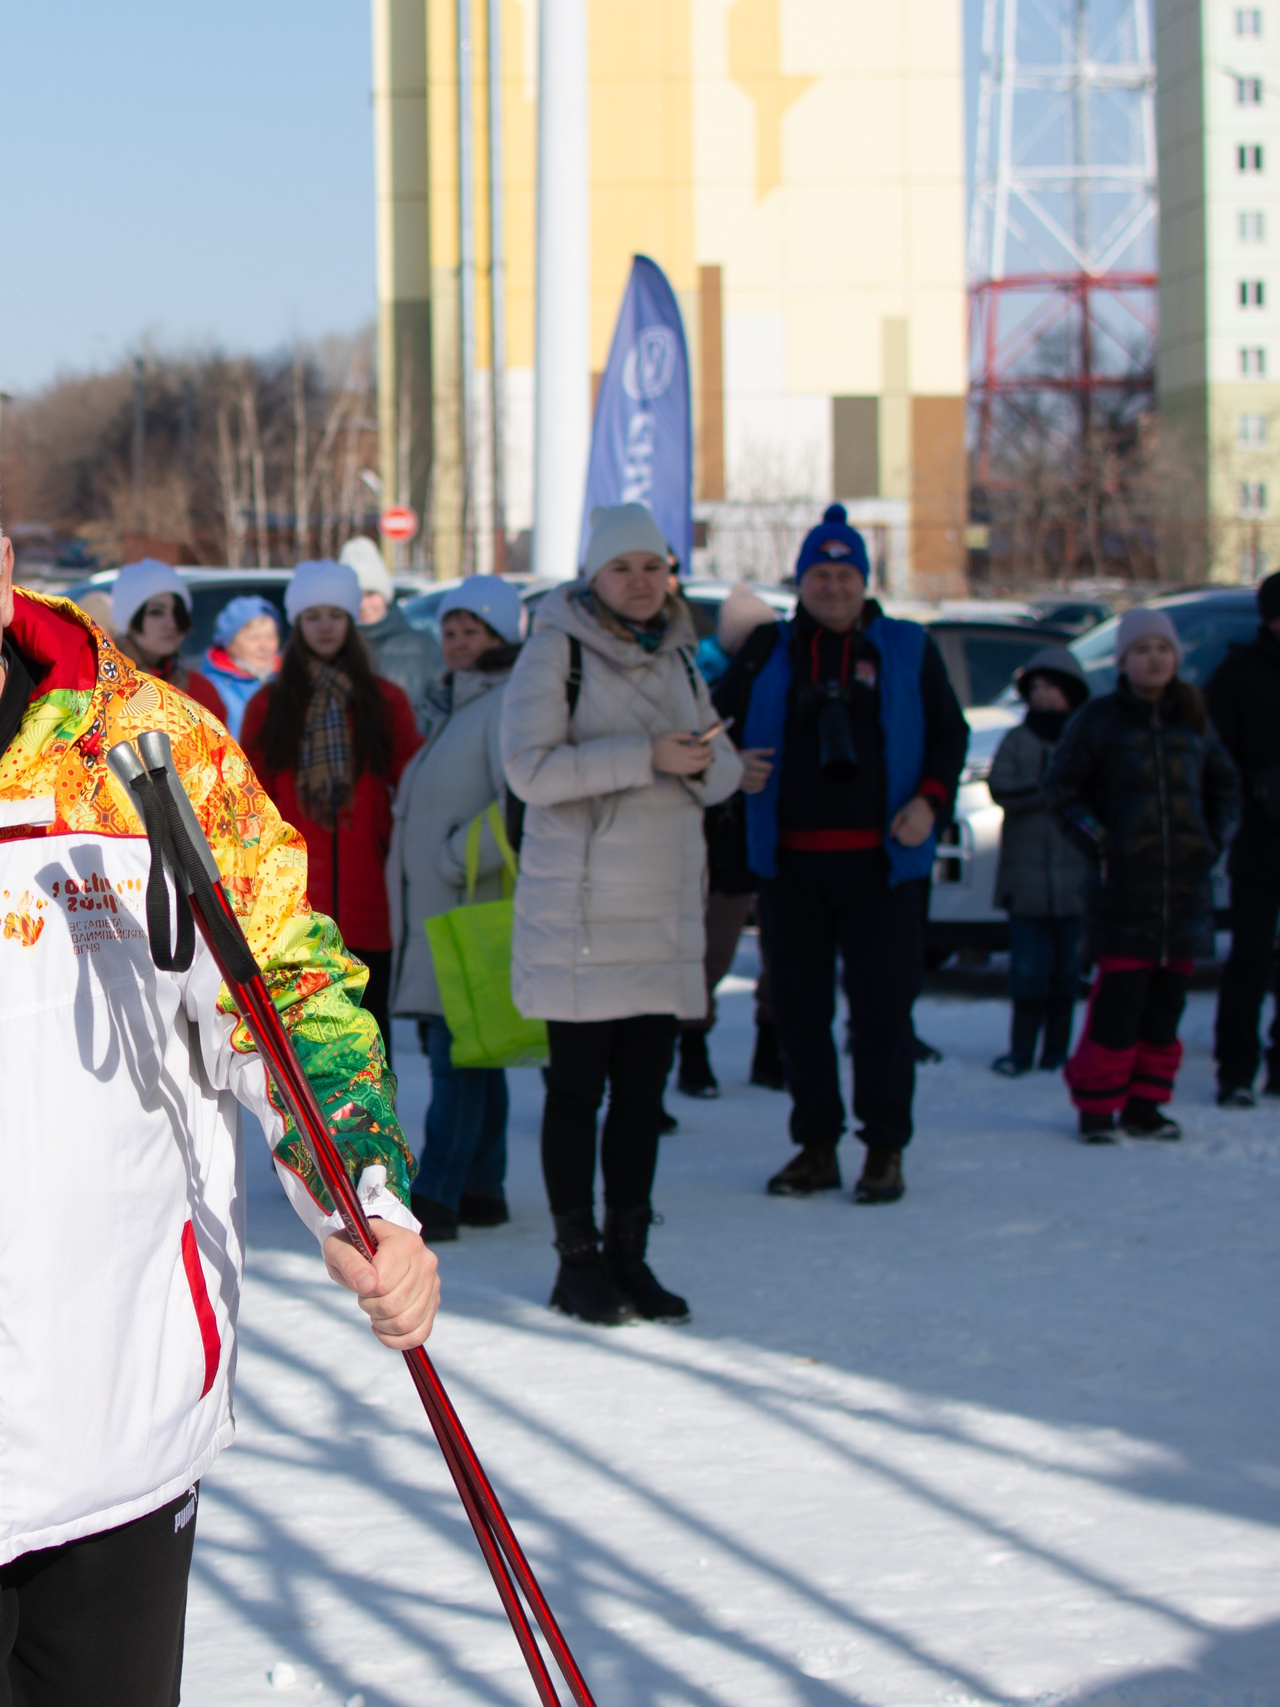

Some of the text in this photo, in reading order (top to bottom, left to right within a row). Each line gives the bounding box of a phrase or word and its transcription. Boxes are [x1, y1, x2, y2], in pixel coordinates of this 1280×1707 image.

[69, 917, 123, 932] ЭСТАФЕТА
[71, 928, 149, 944] ОЛИМПИЙСКОГ
[73, 943, 101, 955] ОГНЯ
